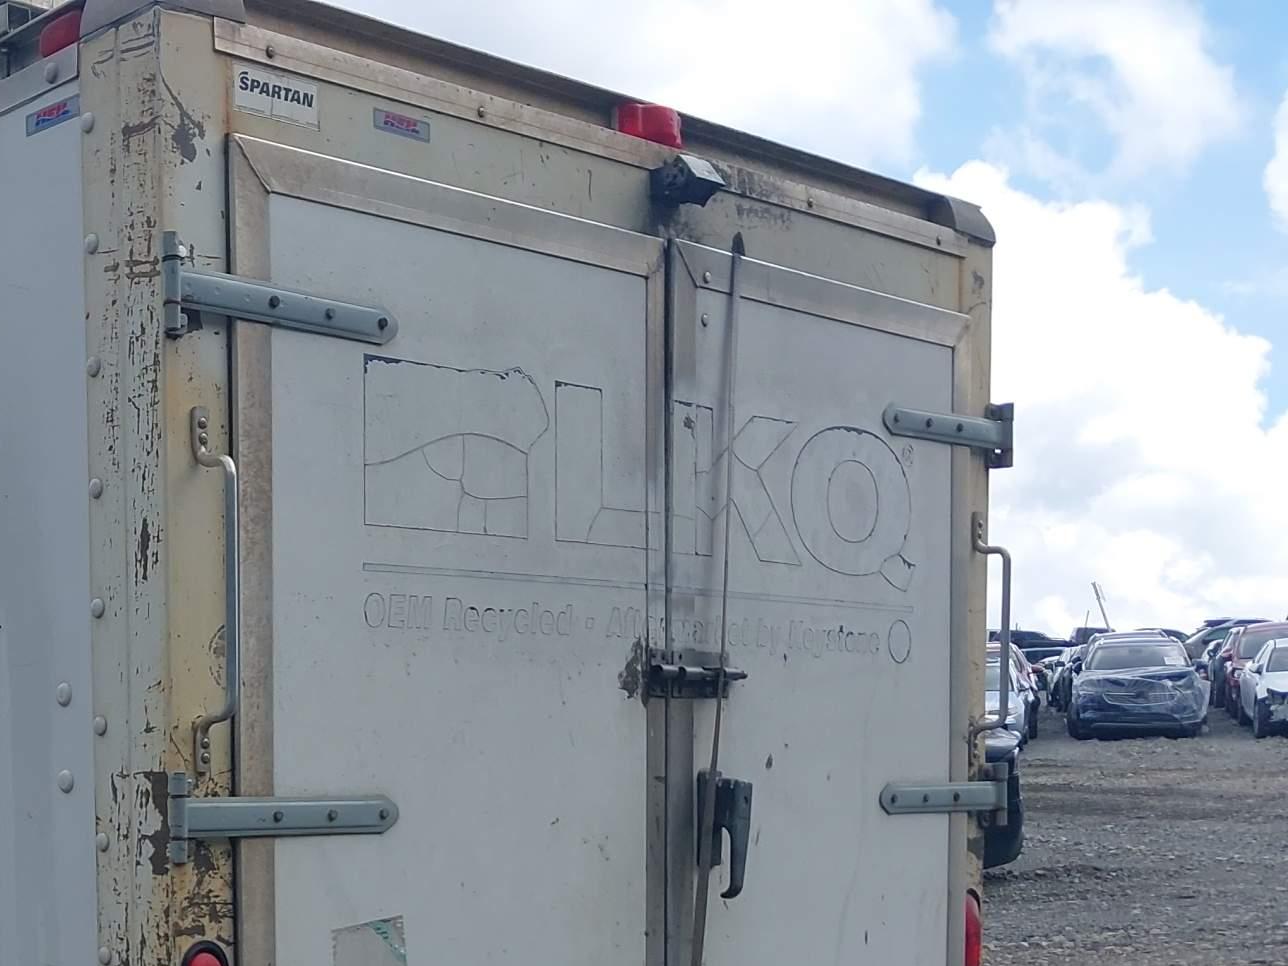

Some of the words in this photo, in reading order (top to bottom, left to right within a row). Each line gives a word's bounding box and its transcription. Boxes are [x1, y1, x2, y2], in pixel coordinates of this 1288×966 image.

[239, 71, 314, 107] SPARTAN
[363, 592, 433, 630] OEM
[443, 596, 573, 643] Recycled
